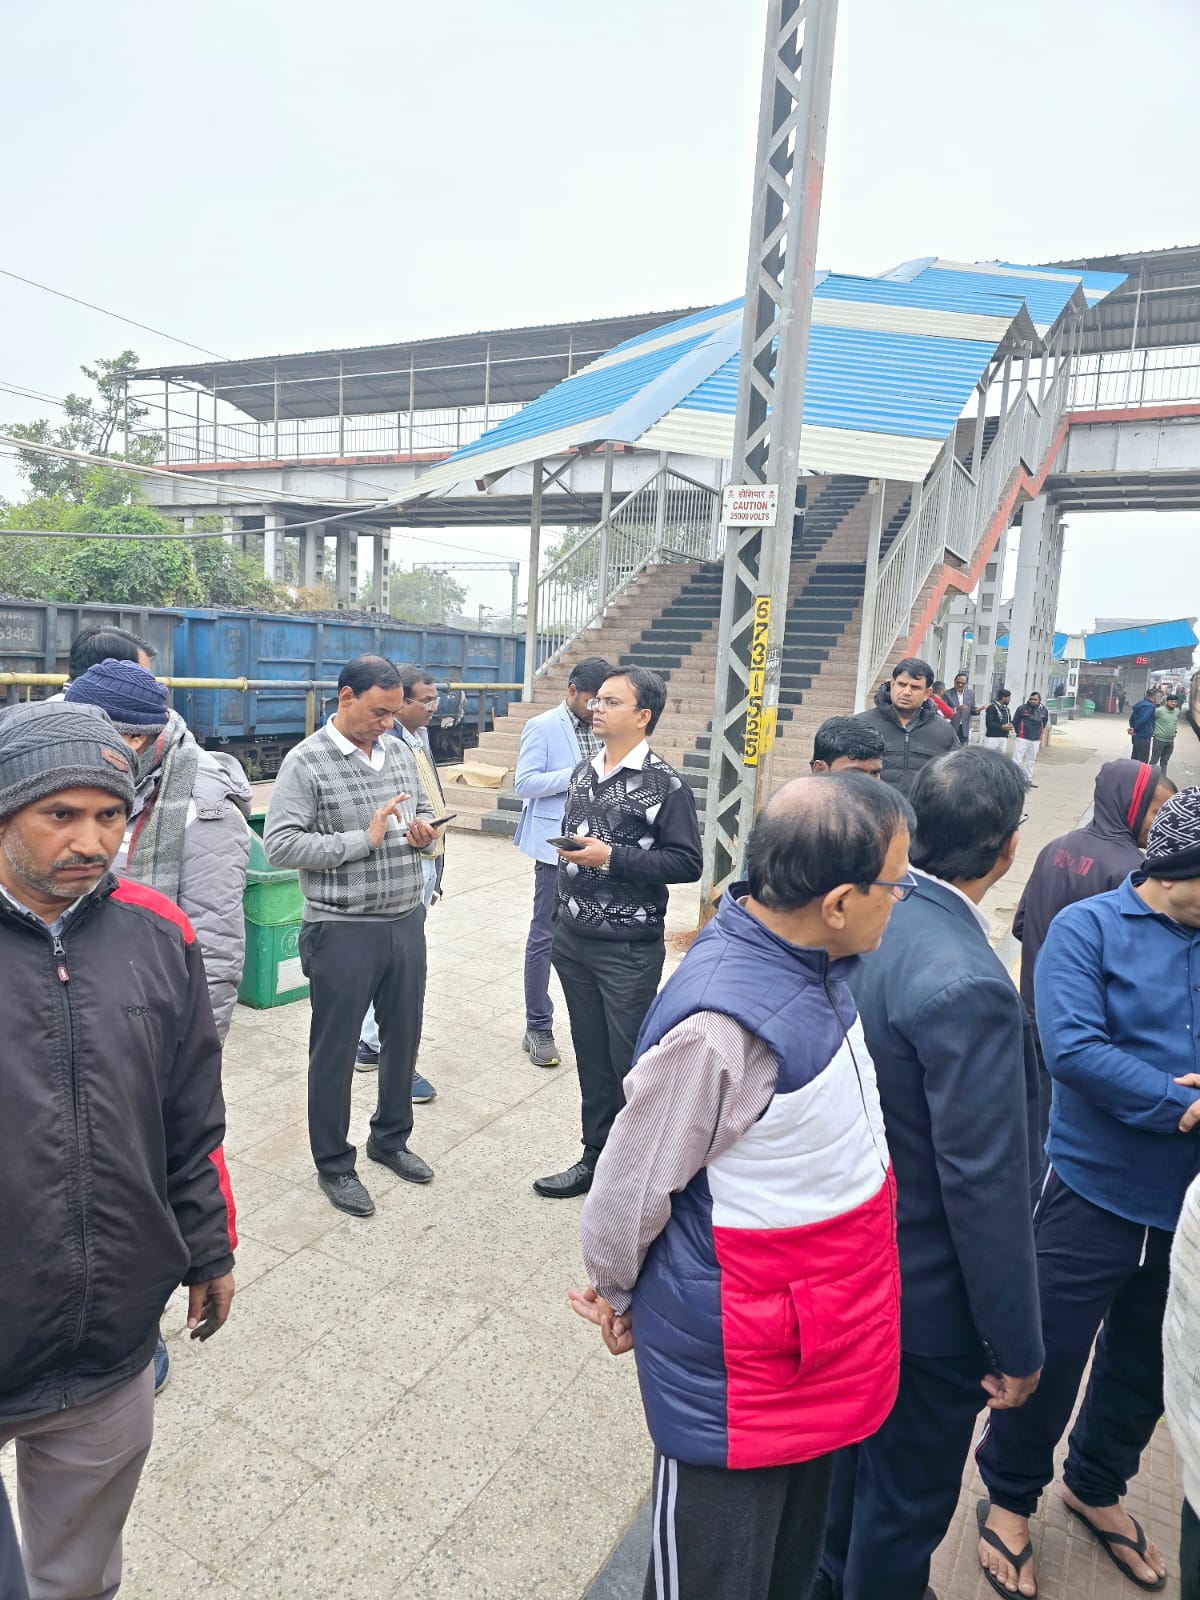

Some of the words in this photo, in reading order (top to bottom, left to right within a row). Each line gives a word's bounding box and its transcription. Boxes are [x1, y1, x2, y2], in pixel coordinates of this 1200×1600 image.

[738, 489, 765, 498] होशियार
[733, 501, 768, 510] CAUTION
[750, 512, 769, 520] VOLTS
